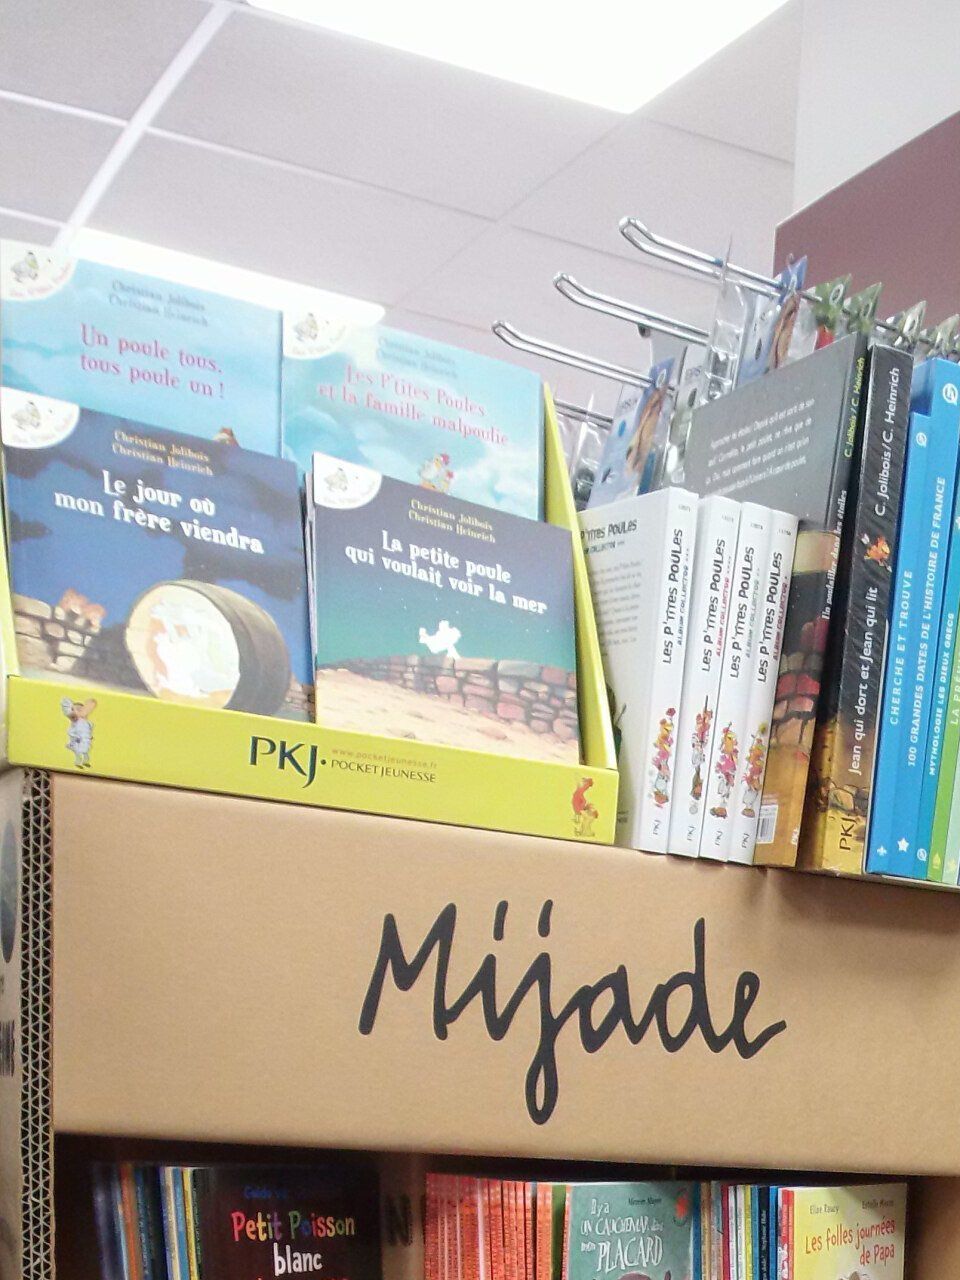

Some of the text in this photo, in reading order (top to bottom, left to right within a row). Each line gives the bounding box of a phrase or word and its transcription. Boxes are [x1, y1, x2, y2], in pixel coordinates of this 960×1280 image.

[80, 322, 109, 347] Un
[118, 337, 169, 360] poule
[80, 353, 213, 397] tous poule un
[346, 364, 374, 384] Les
[436, 388, 486, 417] Poules
[884, 367, 900, 425] Heinrich
[342, 384, 358, 404] la
[365, 392, 424, 420] famille
[102, 469, 217, 517] Le jour où
[54, 491, 265, 555] mon frère viendra
[381, 529, 512, 584] La petite poule
[345, 544, 548, 615] qui voulait voir la mer
[907, 475, 947, 768] 100 GRANDES DATES DE L'HISTOIRE DE FRANCE
[890, 569, 913, 725] CHERCHE ET TROUVE
[939, 649, 951, 684] DIEUX
[848, 586, 879, 775] Jean qui dort et Jean qui lit
[936, 686, 945, 704] LES
[949, 708, 960, 725] LA
[249, 735, 319, 788] PKJ
[929, 705, 943, 776] MYTHOLOGIE
[330, 759, 437, 783] POCKET JEUNESSE
[838, 813, 857, 851] PKJ
[357, 899, 787, 1125] Mijade
[231, 1210, 356, 1242] Petit Poisson
[805, 1217, 897, 1255] Les folles journées
[273, 1242, 323, 1277] blanc
[596, 1236, 664, 1274] PLACARD
[859, 1245, 896, 1266] de Papa
